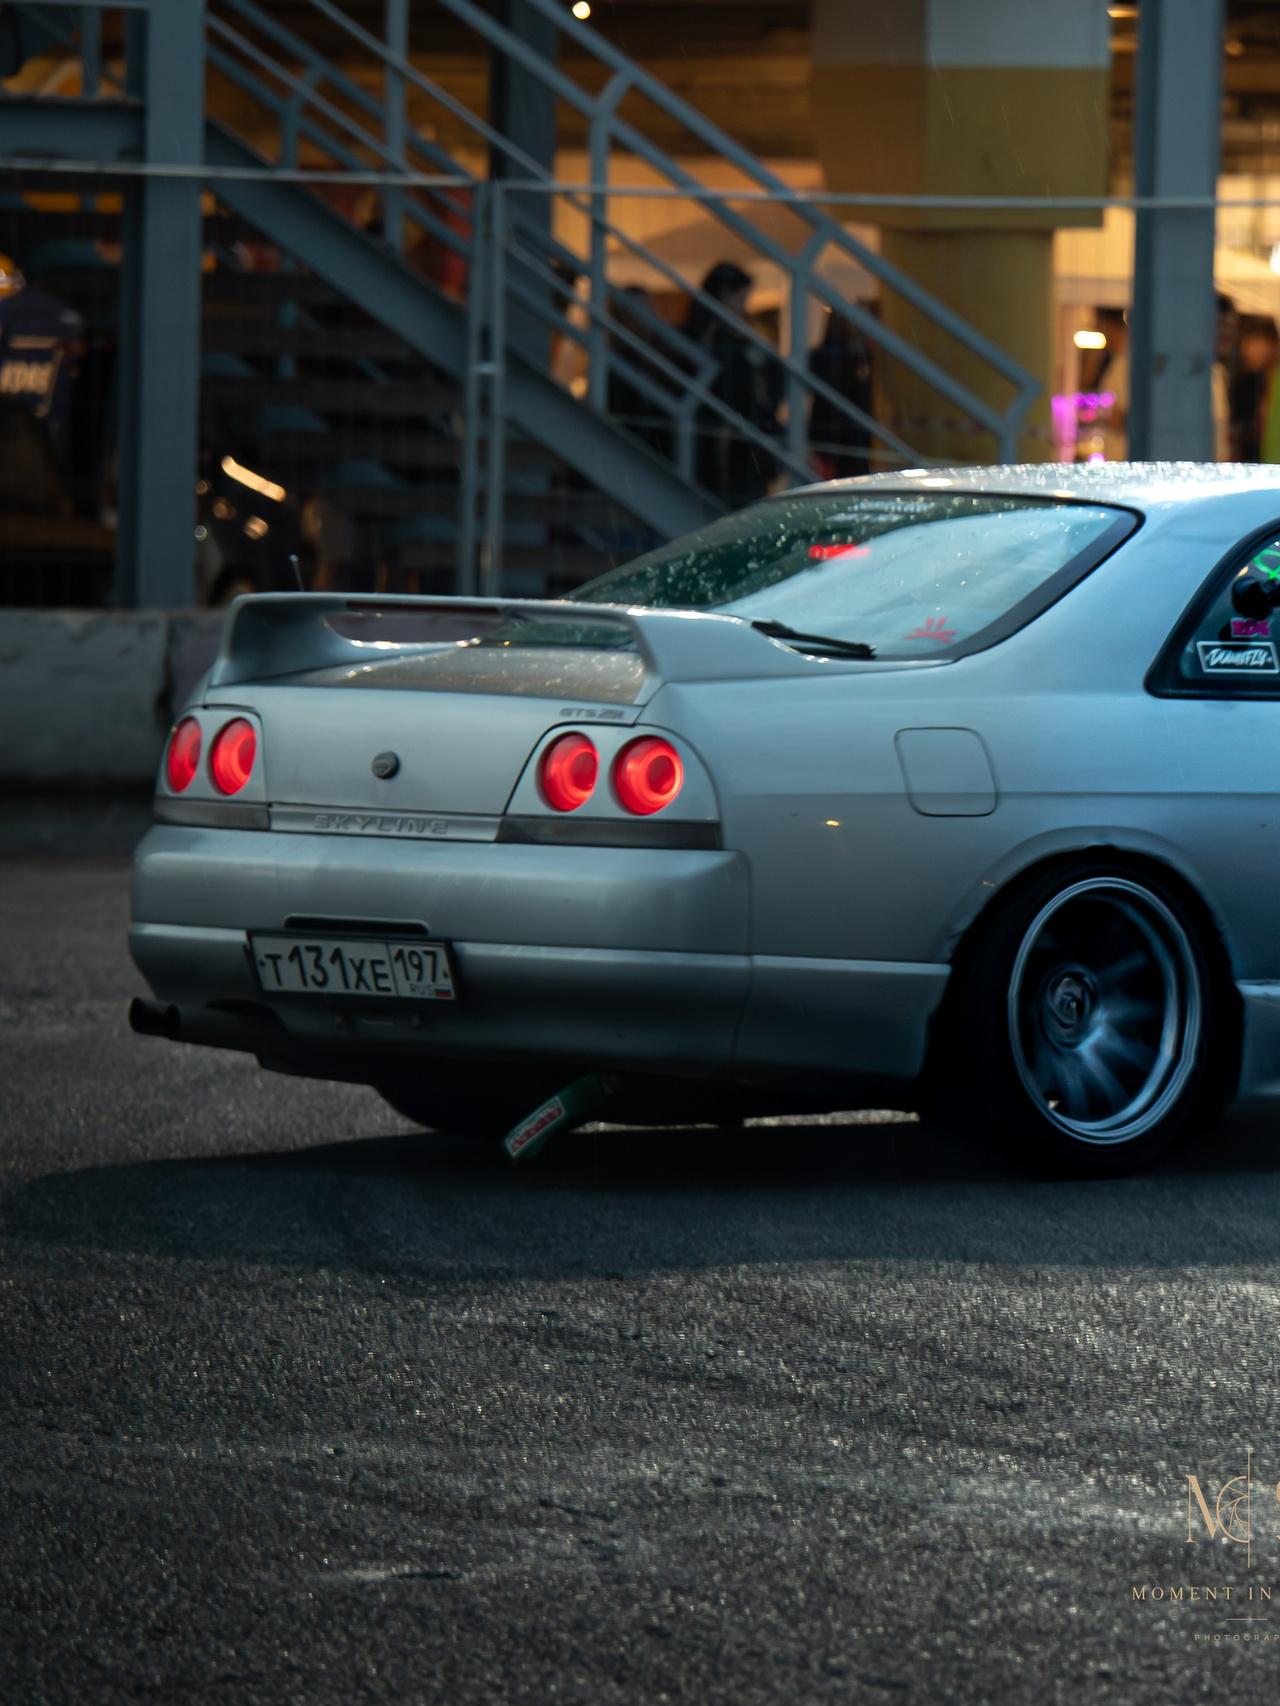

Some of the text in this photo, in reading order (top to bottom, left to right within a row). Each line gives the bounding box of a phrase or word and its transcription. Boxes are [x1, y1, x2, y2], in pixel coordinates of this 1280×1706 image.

[314, 814, 449, 835] SKYLINE
[394, 948, 438, 983] 197
[409, 983, 435, 996] RUS
